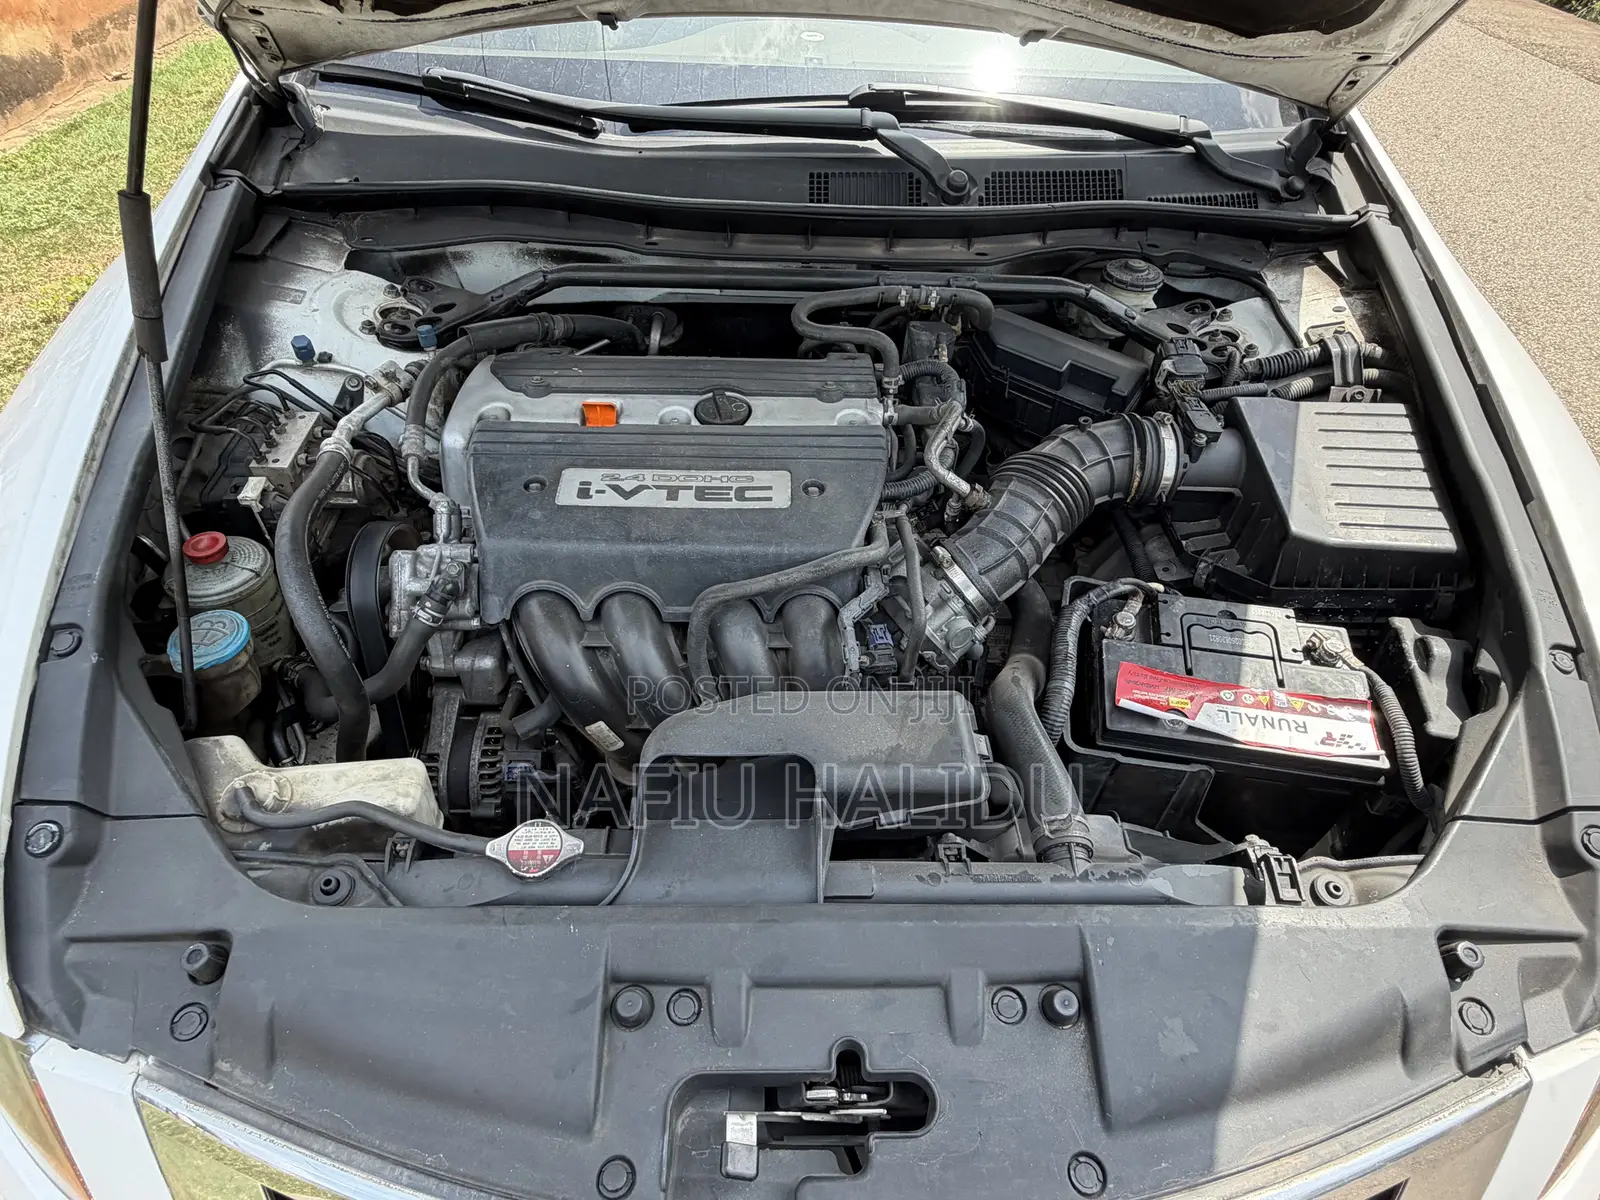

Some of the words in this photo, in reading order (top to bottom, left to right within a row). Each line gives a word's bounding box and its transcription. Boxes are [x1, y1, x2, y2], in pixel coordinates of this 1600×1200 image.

[601, 473, 646, 482] 2.4
[652, 474, 755, 483] DOHC
[576, 481, 773, 502] i-VTEC
[1217, 708, 1309, 735] RUNALL
